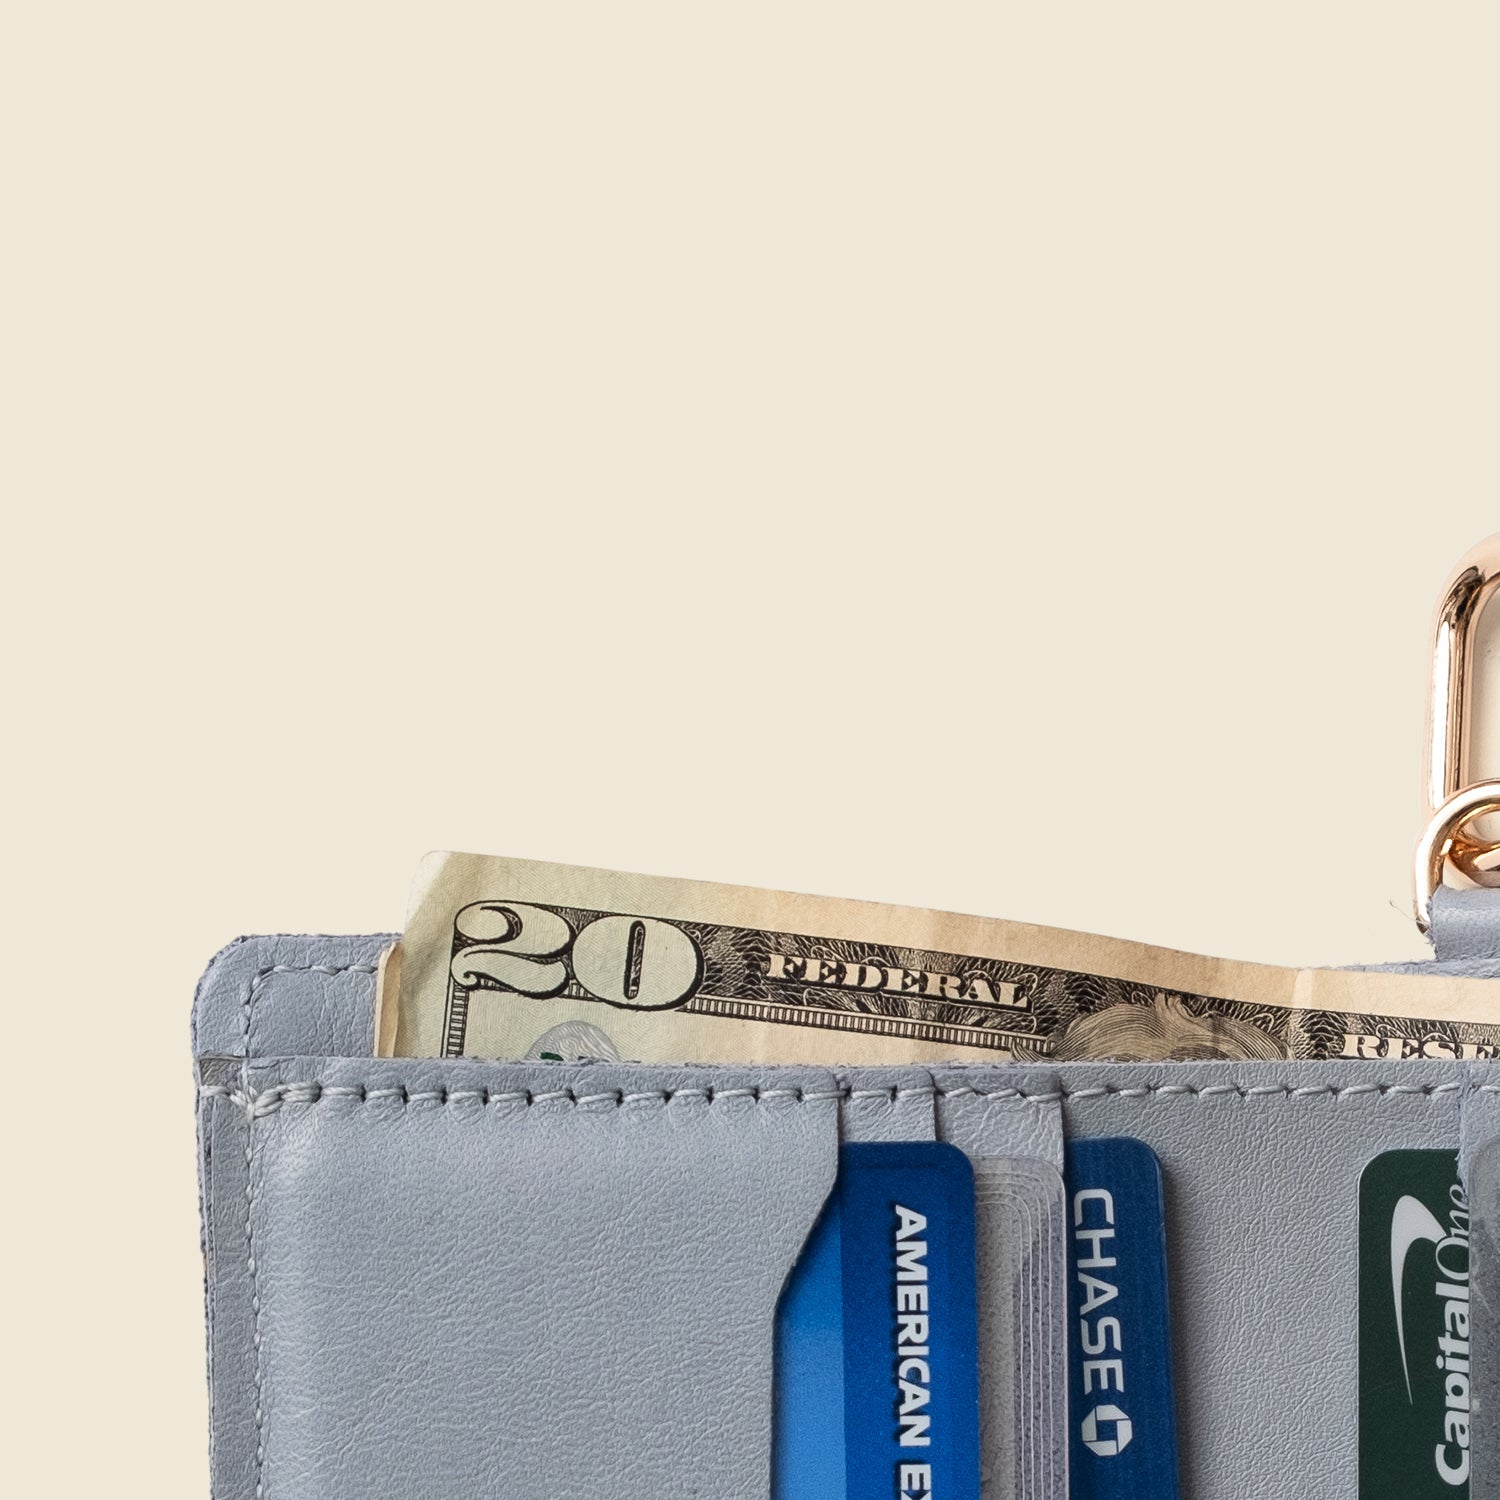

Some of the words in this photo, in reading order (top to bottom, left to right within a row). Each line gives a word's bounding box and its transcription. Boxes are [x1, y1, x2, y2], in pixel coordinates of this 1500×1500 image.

[451, 900, 706, 1012] 20
[767, 952, 1031, 1009] FEDERAL
[893, 1204, 931, 1448] AMERICAN
[1073, 1187, 1126, 1396] CHASE
